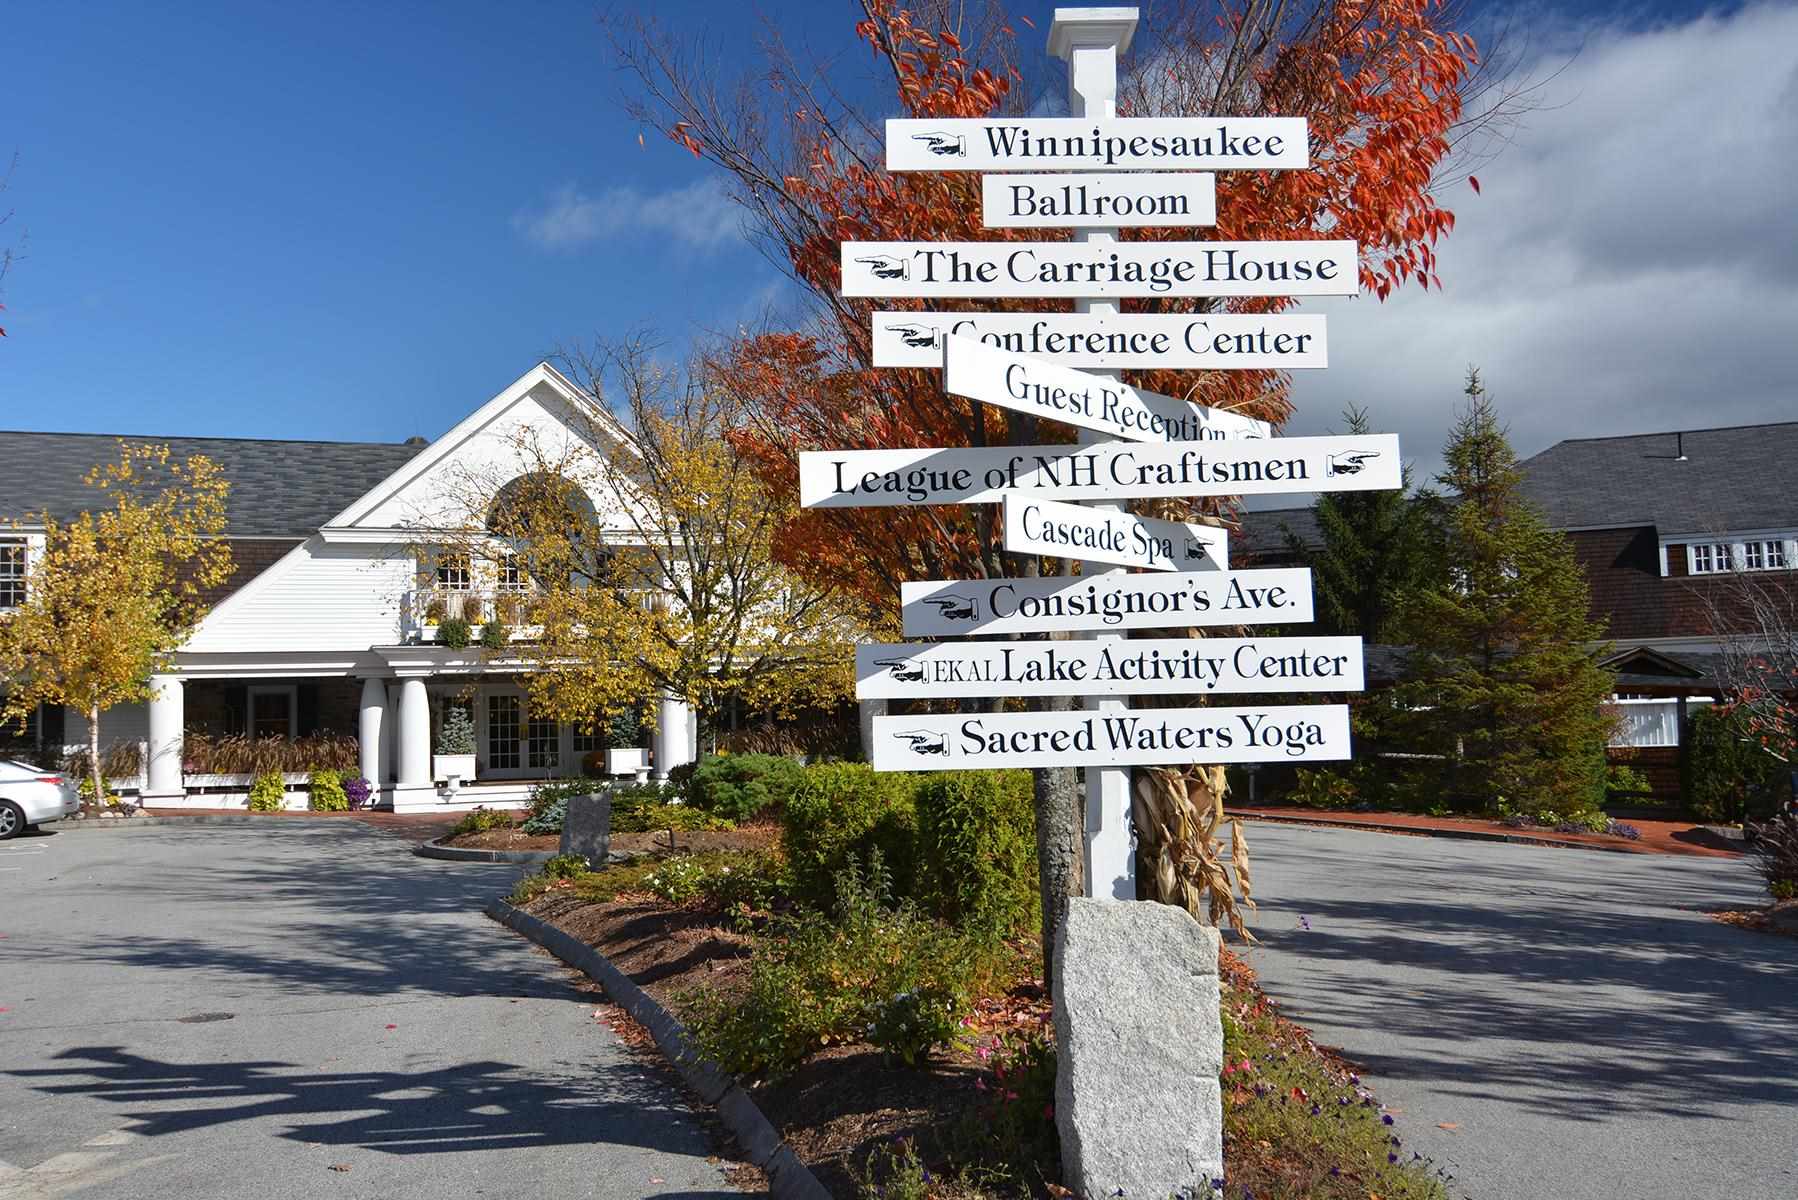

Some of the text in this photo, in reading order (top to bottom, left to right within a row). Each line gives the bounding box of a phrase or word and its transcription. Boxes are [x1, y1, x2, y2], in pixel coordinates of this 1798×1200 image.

[984, 126, 1284, 165] Winnipesaukee
[1008, 184, 1190, 216] Ballroom
[914, 248, 1338, 292] The Carriage House
[1183, 321, 1311, 355] Center
[1006, 363, 1093, 416] Guest
[832, 451, 1308, 501] League of NH Craftsmen
[1022, 505, 1175, 560] Cascade Spa
[989, 577, 1295, 624] Consignor's Ave.
[934, 643, 1348, 689] EKAL Lake Activity Center
[960, 714, 1326, 756] Sacred Waters Yoga
